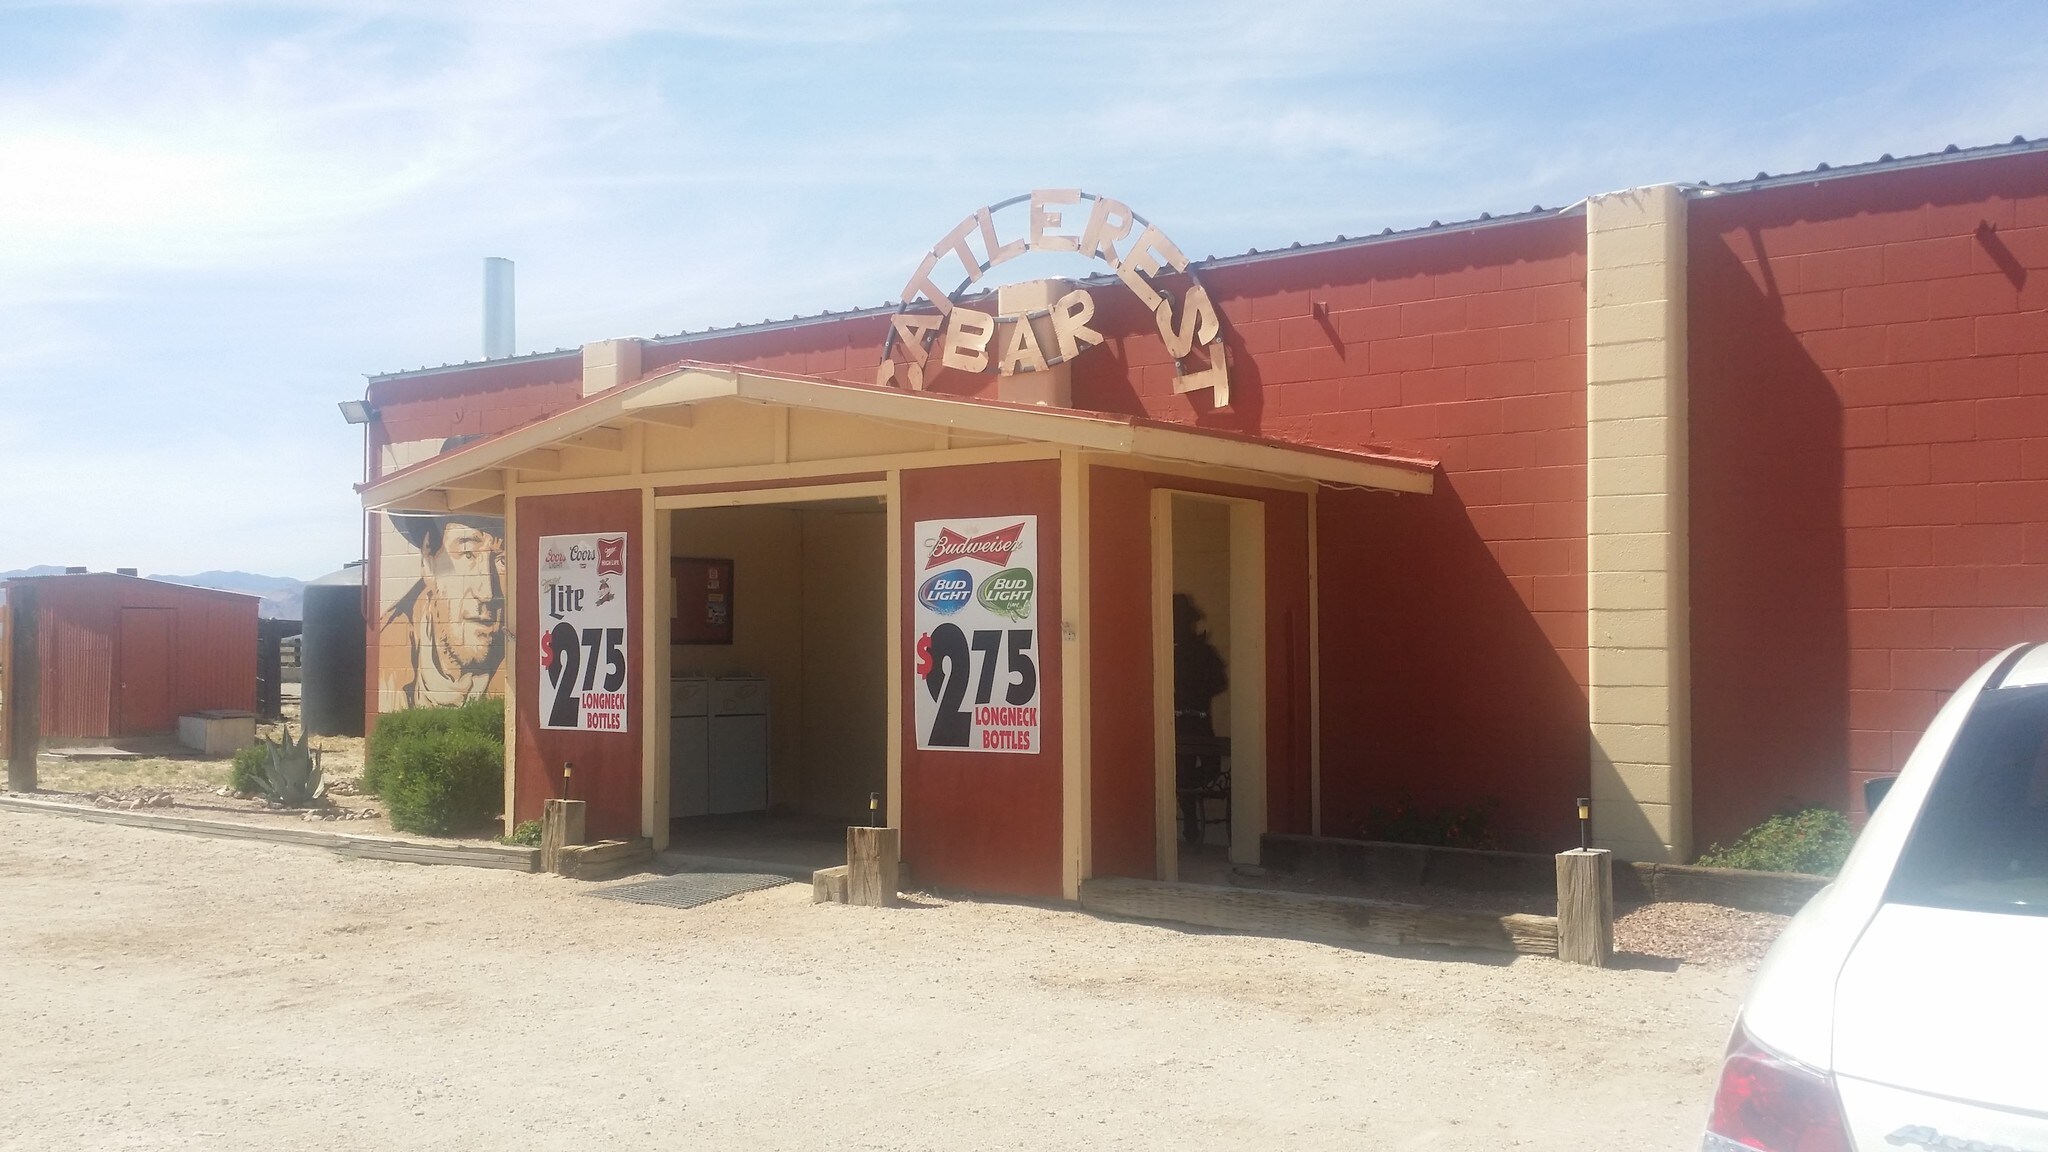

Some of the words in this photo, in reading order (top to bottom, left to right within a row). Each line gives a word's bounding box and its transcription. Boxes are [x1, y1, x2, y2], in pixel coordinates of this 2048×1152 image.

[942, 289, 1104, 377] BAR
[570, 545, 596, 561] Coors
[924, 535, 1023, 558] Budweiser
[545, 549, 567, 562] Coors
[934, 579, 967, 590] BUD
[993, 579, 1027, 590] BUD
[549, 584, 584, 620] Lite
[926, 590, 971, 601] LIGHT
[986, 590, 1031, 601] LIGHT
[582, 693, 625, 710] LONGNECK
[587, 712, 620, 730] BOTTLES
[975, 706, 1037, 727] LONGNECK
[982, 730, 1031, 750] BOTTLES
